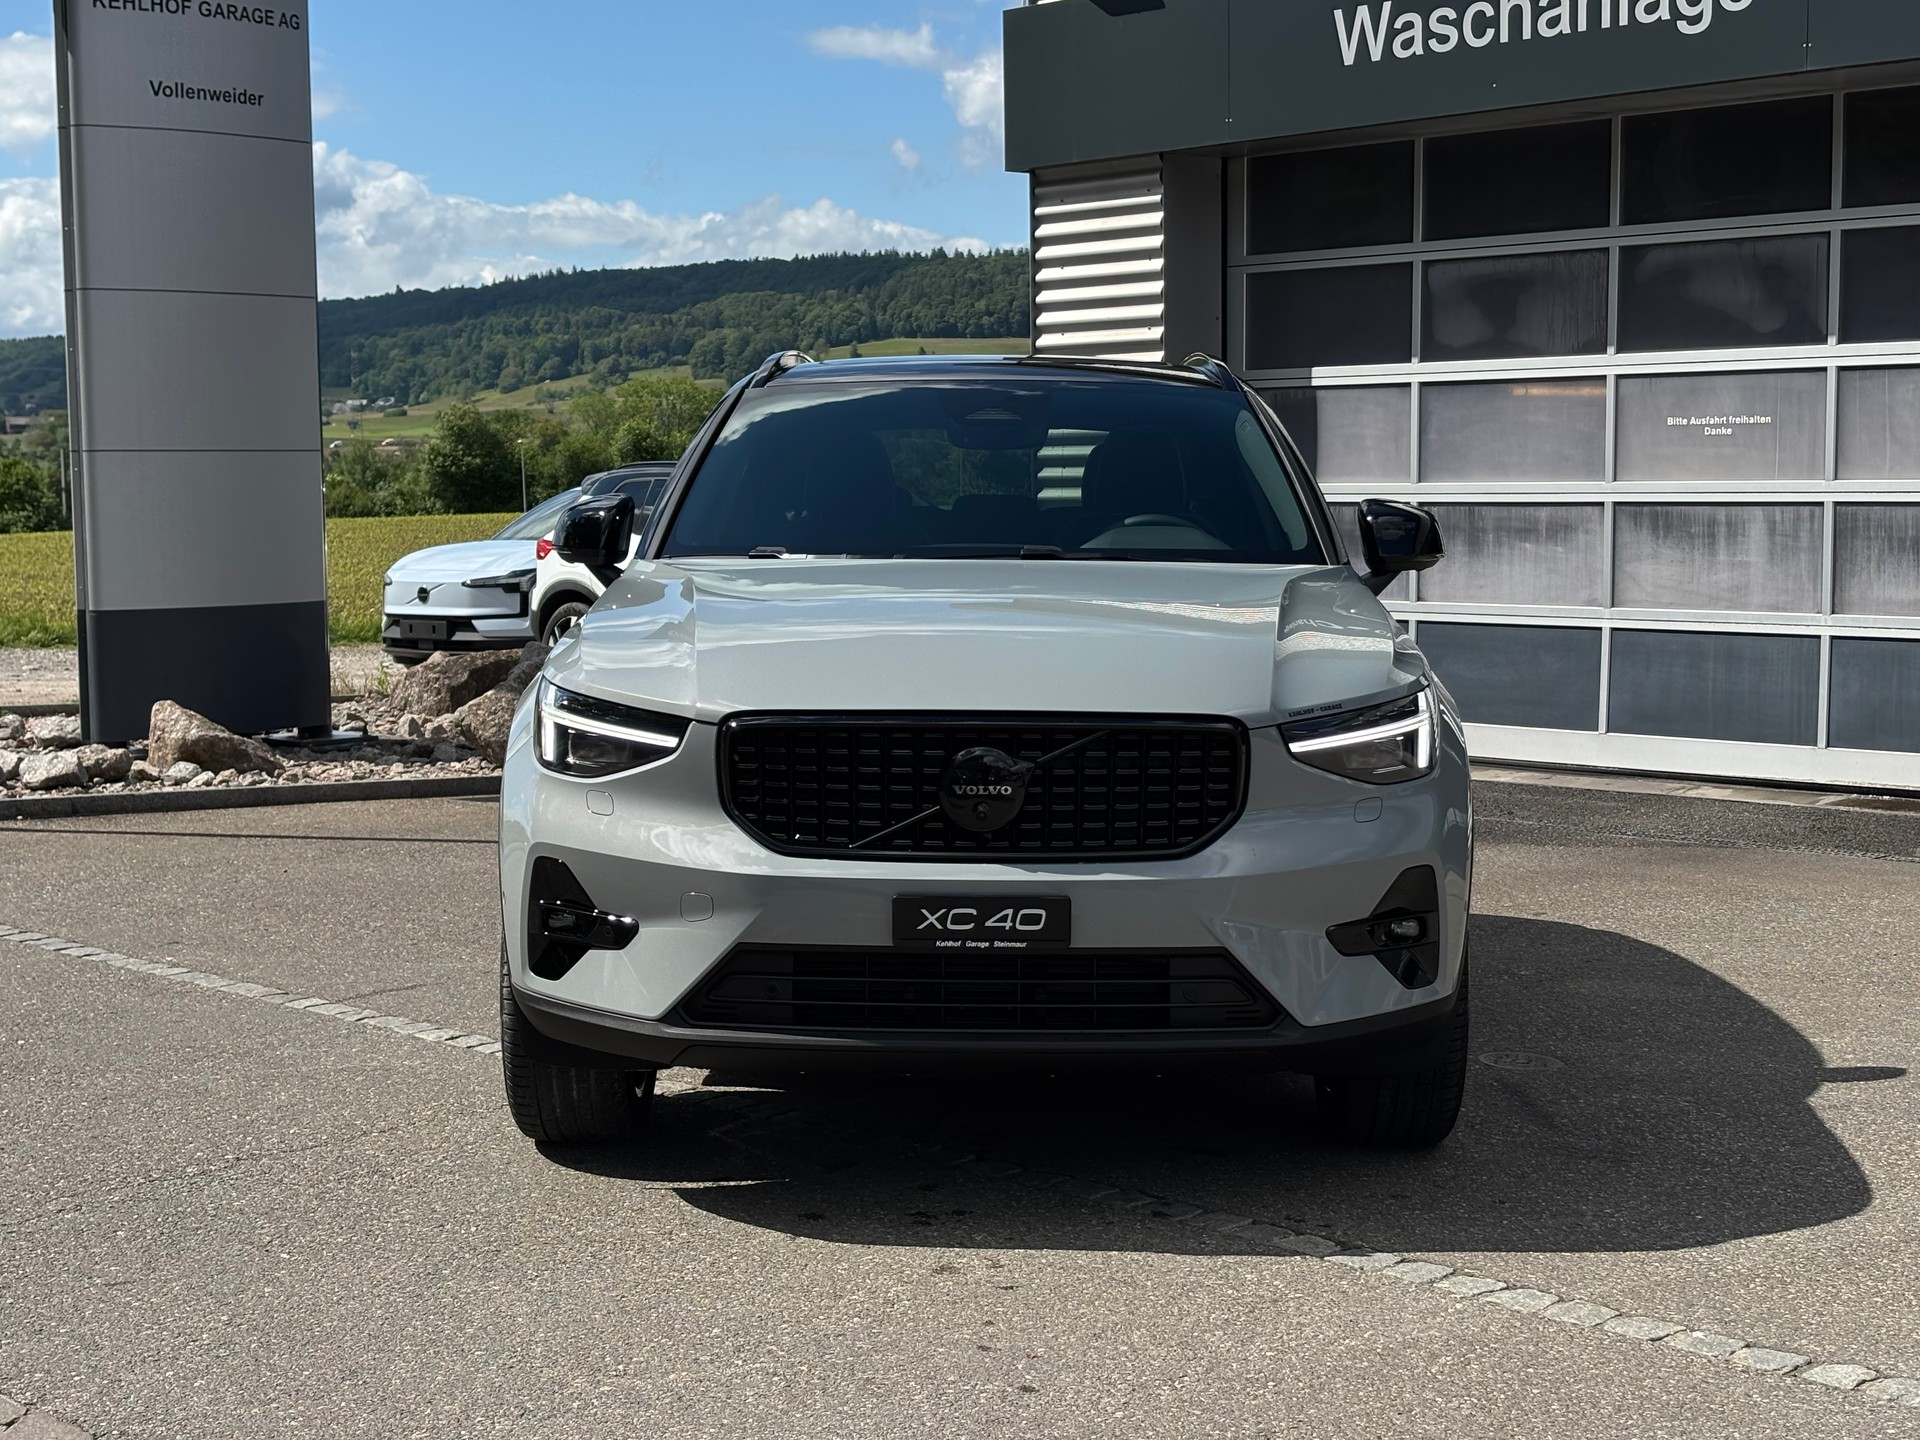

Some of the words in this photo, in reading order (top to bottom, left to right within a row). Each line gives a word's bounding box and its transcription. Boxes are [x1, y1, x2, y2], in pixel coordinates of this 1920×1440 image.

[92, 0, 192, 15] KEHLHOF
[198, 1, 275, 26] GARAGE
[279, 12, 301, 30] AG
[1334, 0, 1753, 66] Waschanag
[149, 80, 264, 106] Vollenweider
[1667, 417, 1688, 426] Bitte
[1690, 416, 1727, 425] Ausfahrt
[1729, 415, 1772, 424] freihalten
[1704, 427, 1733, 436] Danke
[952, 785, 1012, 795] VOLVO
[916, 908, 978, 931] XC
[984, 908, 1047, 931] 40
[936, 940, 962, 948] Kehlhof
[965, 940, 990, 949] Garage
[993, 940, 1028, 948] Steinmaur
